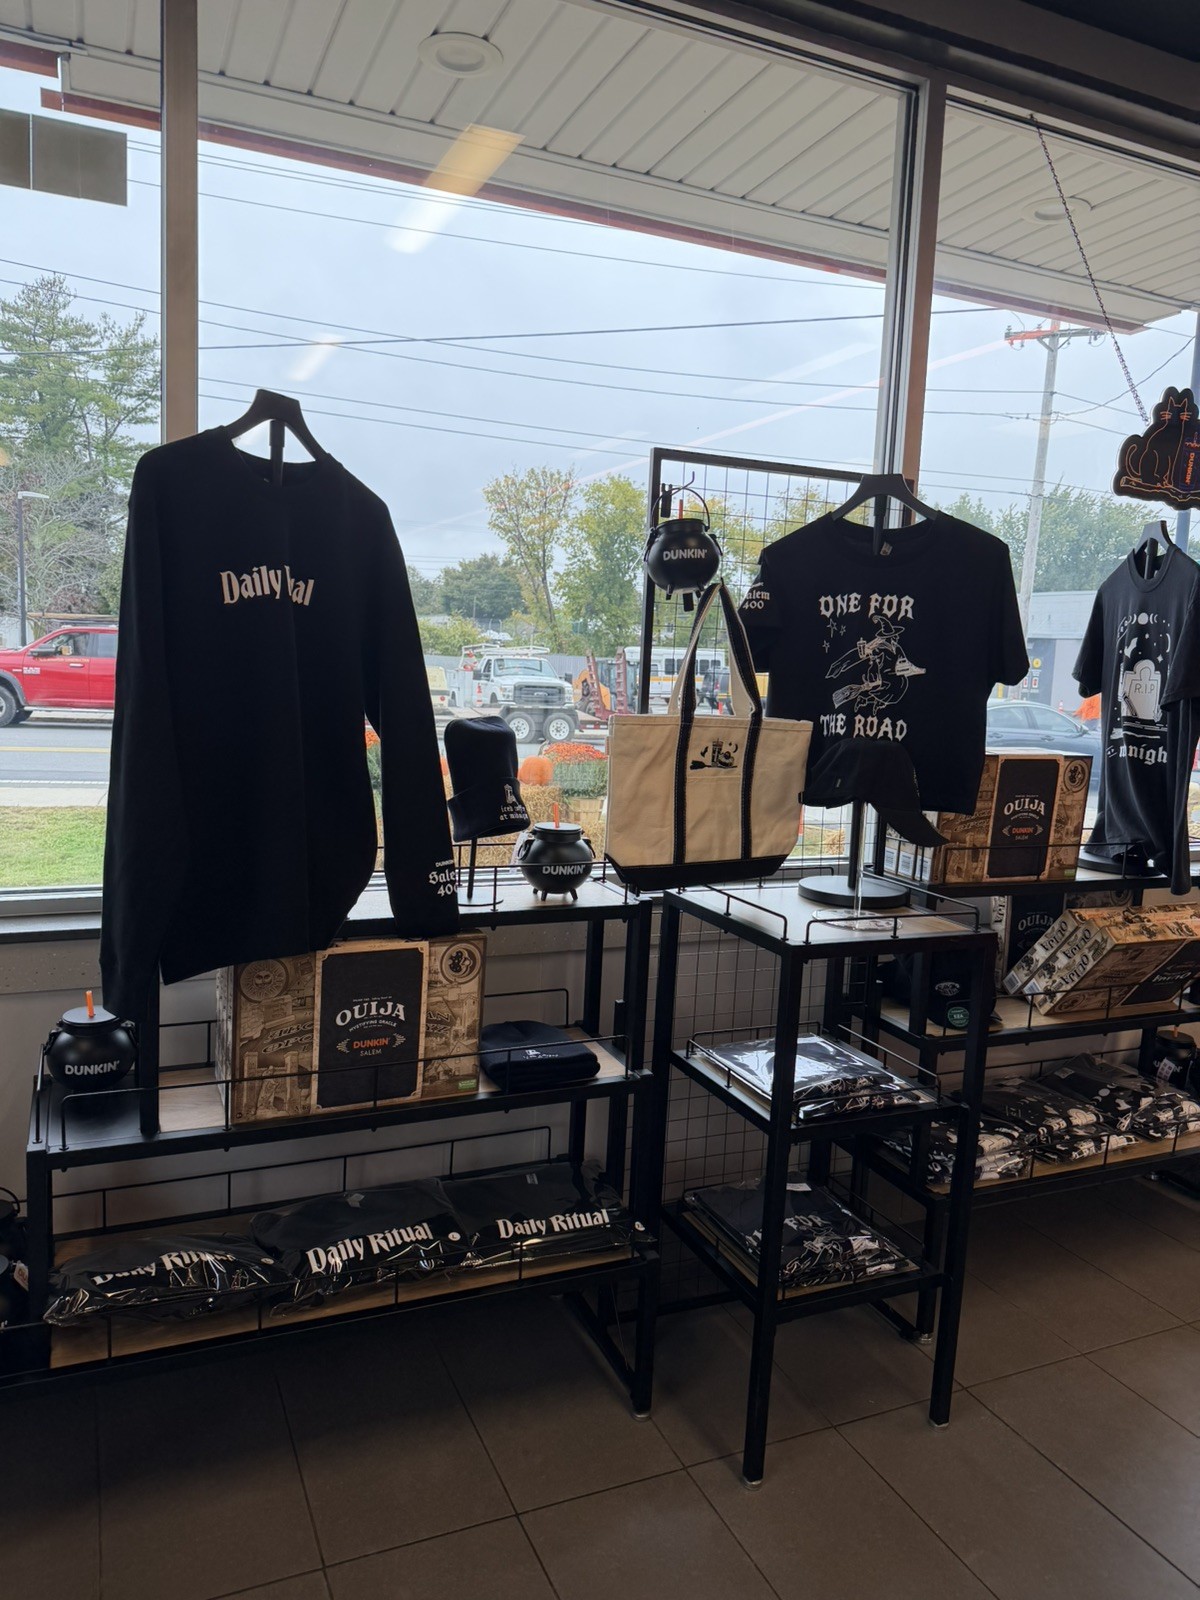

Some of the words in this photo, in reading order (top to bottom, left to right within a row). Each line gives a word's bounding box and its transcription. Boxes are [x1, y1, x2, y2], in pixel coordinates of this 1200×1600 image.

[663, 549, 707, 560] DUNKIN'
[220, 565, 282, 604] Daily
[746, 589, 770, 600] alem
[743, 600, 764, 609] 400
[819, 592, 862, 618] ONE
[868, 593, 915, 620] FOR
[820, 713, 847, 737] THE
[853, 714, 907, 742] ROAD
[1003, 798, 1045, 816] OUIJA
[428, 869, 457, 885] Sale
[542, 864, 586, 876] DUNKIN'
[335, 1001, 406, 1027] OUIJA
[64, 1060, 120, 1076] DUNKIN'
[496, 1218, 546, 1239] Daily
[549, 1208, 610, 1232] Ritual
[306, 1238, 364, 1275] Daily
[367, 1222, 434, 1255] Ritual
